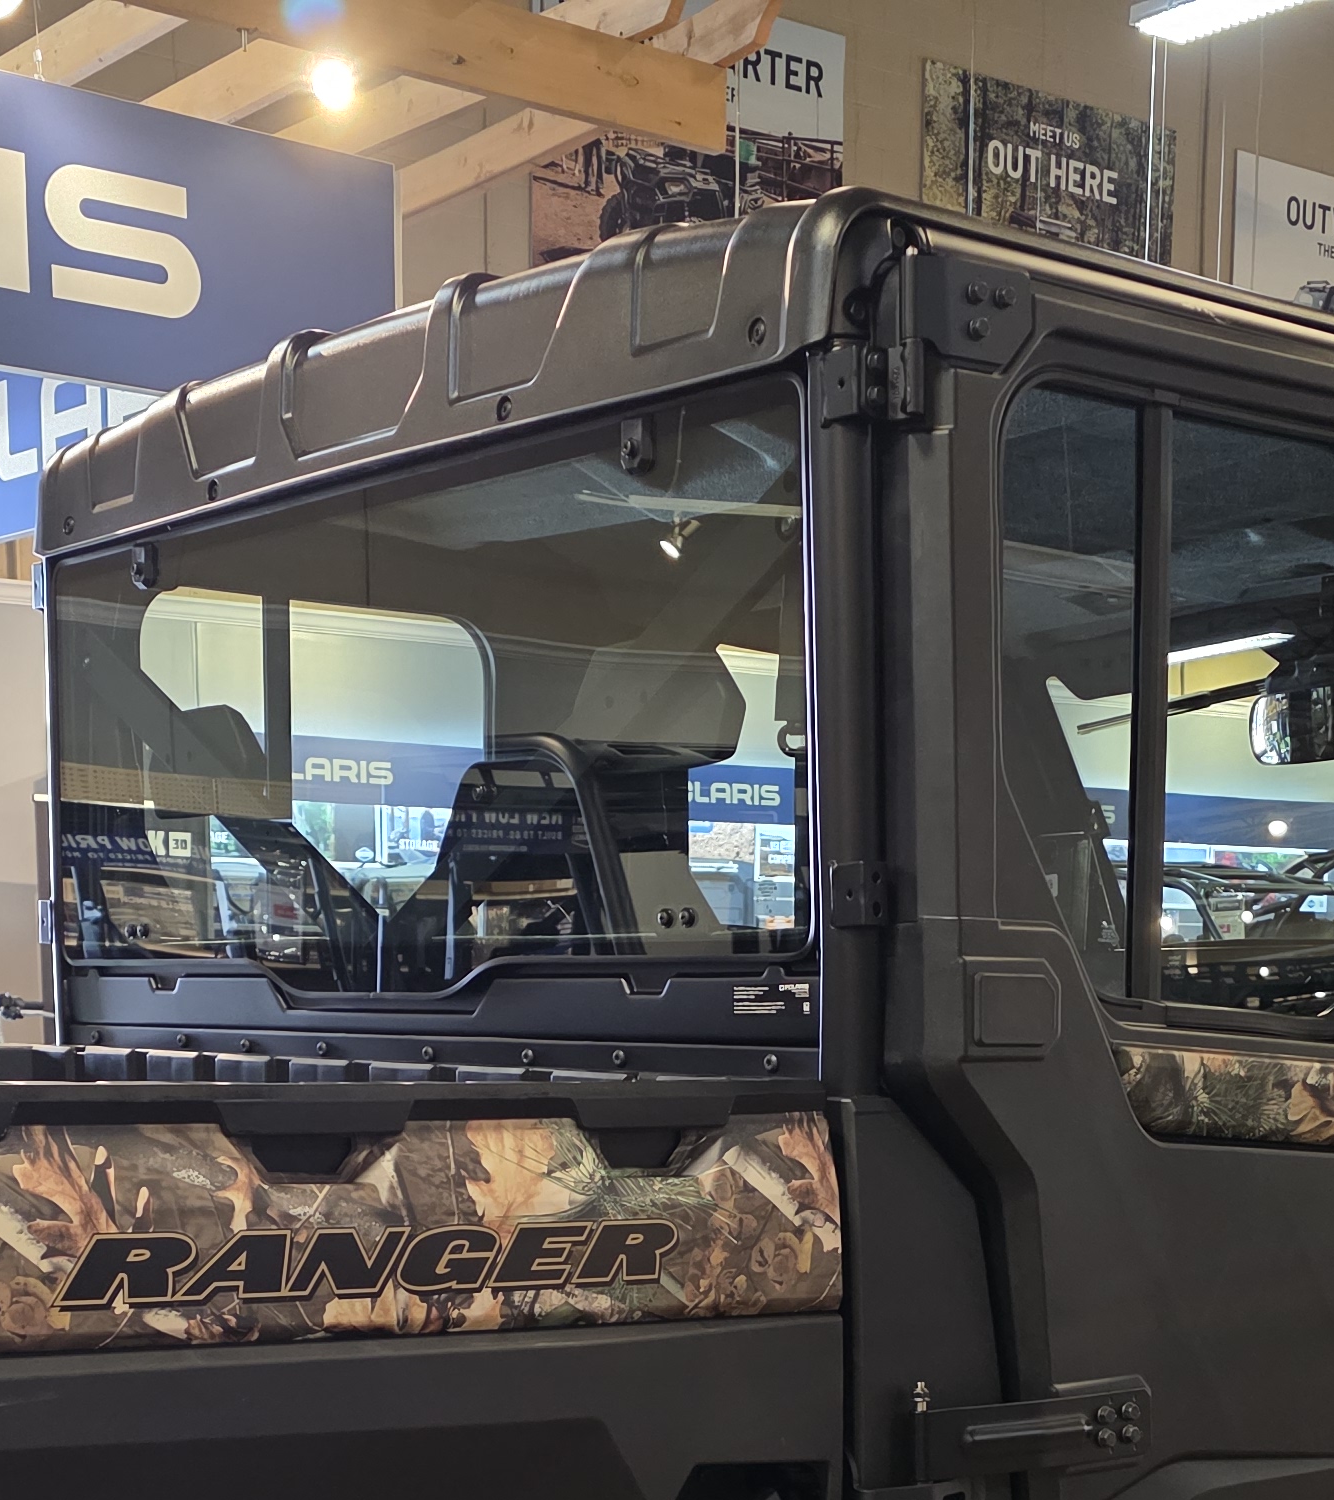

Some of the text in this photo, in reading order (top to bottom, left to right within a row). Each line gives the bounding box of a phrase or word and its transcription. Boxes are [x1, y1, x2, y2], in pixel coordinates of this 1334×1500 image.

[728, 48, 823, 98] RTER
[1030, 121, 1080, 149] MEET US
[987, 139, 1118, 205] OUT HERE
[52, 1217, 679, 1311] RANGER
